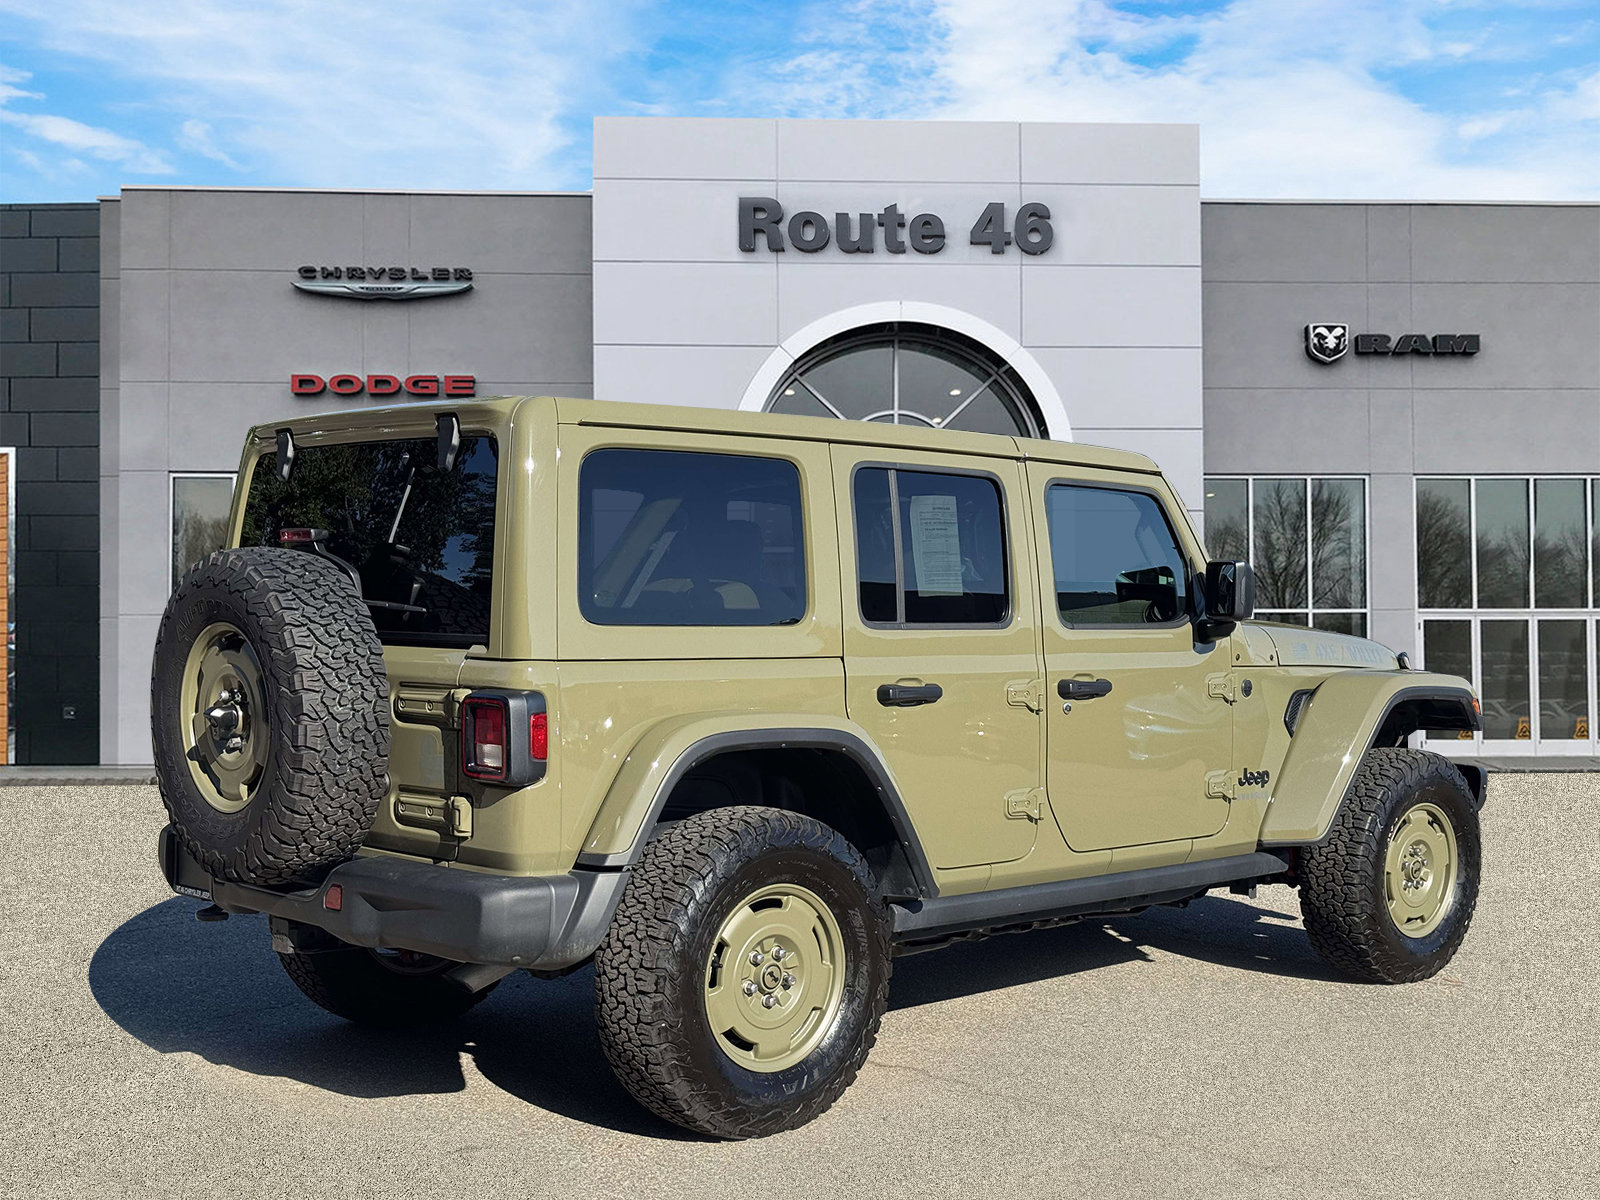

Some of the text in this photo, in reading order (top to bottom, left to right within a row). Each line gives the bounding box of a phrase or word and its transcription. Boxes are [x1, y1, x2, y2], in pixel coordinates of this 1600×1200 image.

[738, 196, 1055, 256] Route 46
[297, 265, 473, 281] CHRYSLER
[1353, 333, 1481, 356] RAM
[290, 373, 476, 396] DODGE
[1238, 767, 1270, 788] Jeep
